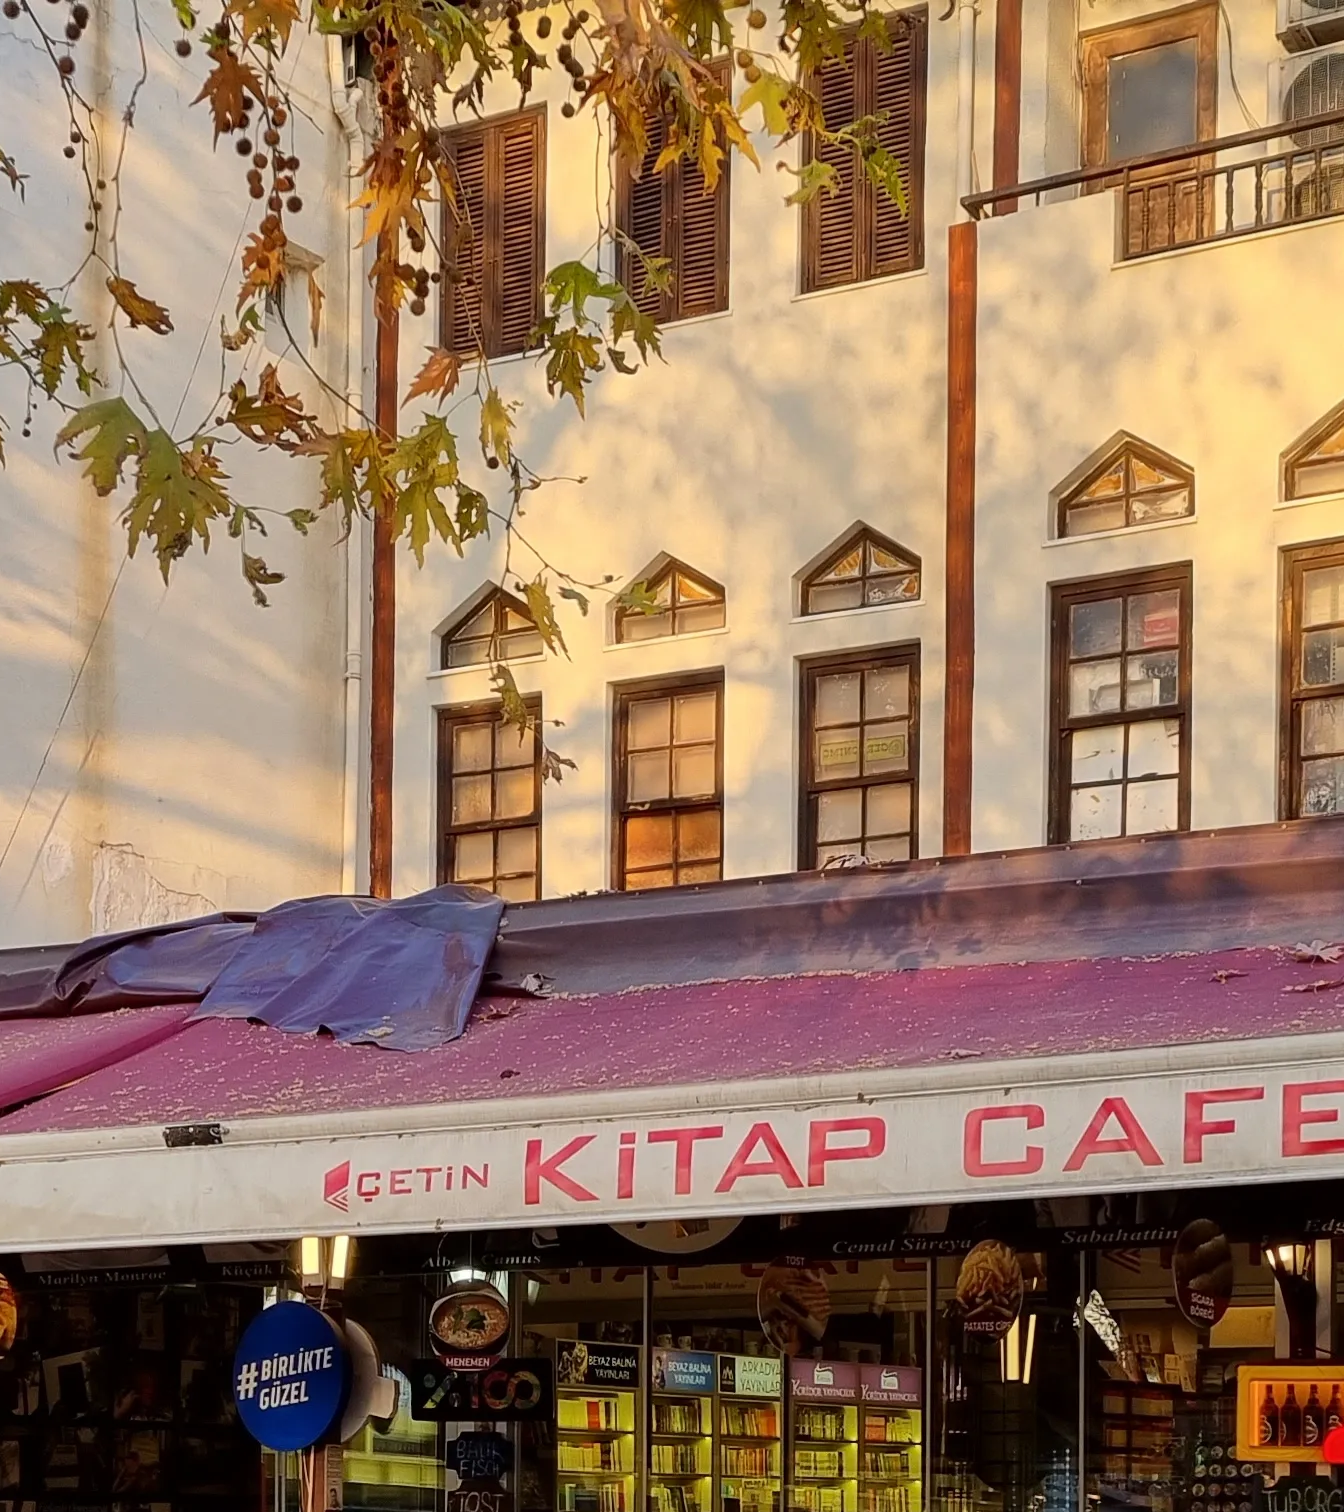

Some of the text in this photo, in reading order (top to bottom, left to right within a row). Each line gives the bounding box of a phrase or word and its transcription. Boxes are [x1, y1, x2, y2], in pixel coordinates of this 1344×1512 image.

[355, 1162, 489, 1203] ÇETİN
[523, 1115, 887, 1206] KİTAP
[1060, 1227, 1178, 1245] Sabahattin
[832, 1236, 973, 1254] Cemal Süreya
[481, 1253, 542, 1266] Camus
[785, 1255, 806, 1267] TOST
[38, 1269, 167, 1287] Marilyn Monroe
[221, 1264, 273, 1279] Küçük
[963, 1321, 994, 1333] PATATES
[445, 1357, 491, 1368] MENEMEN
[588, 1355, 611, 1368] BEYAZ
[667, 1361, 689, 1374] BEYAZ
[594, 1367, 630, 1380] YAYINLARI
[259, 1380, 309, 1411] GÜZEL
[459, 1460, 500, 1478] FISCH
